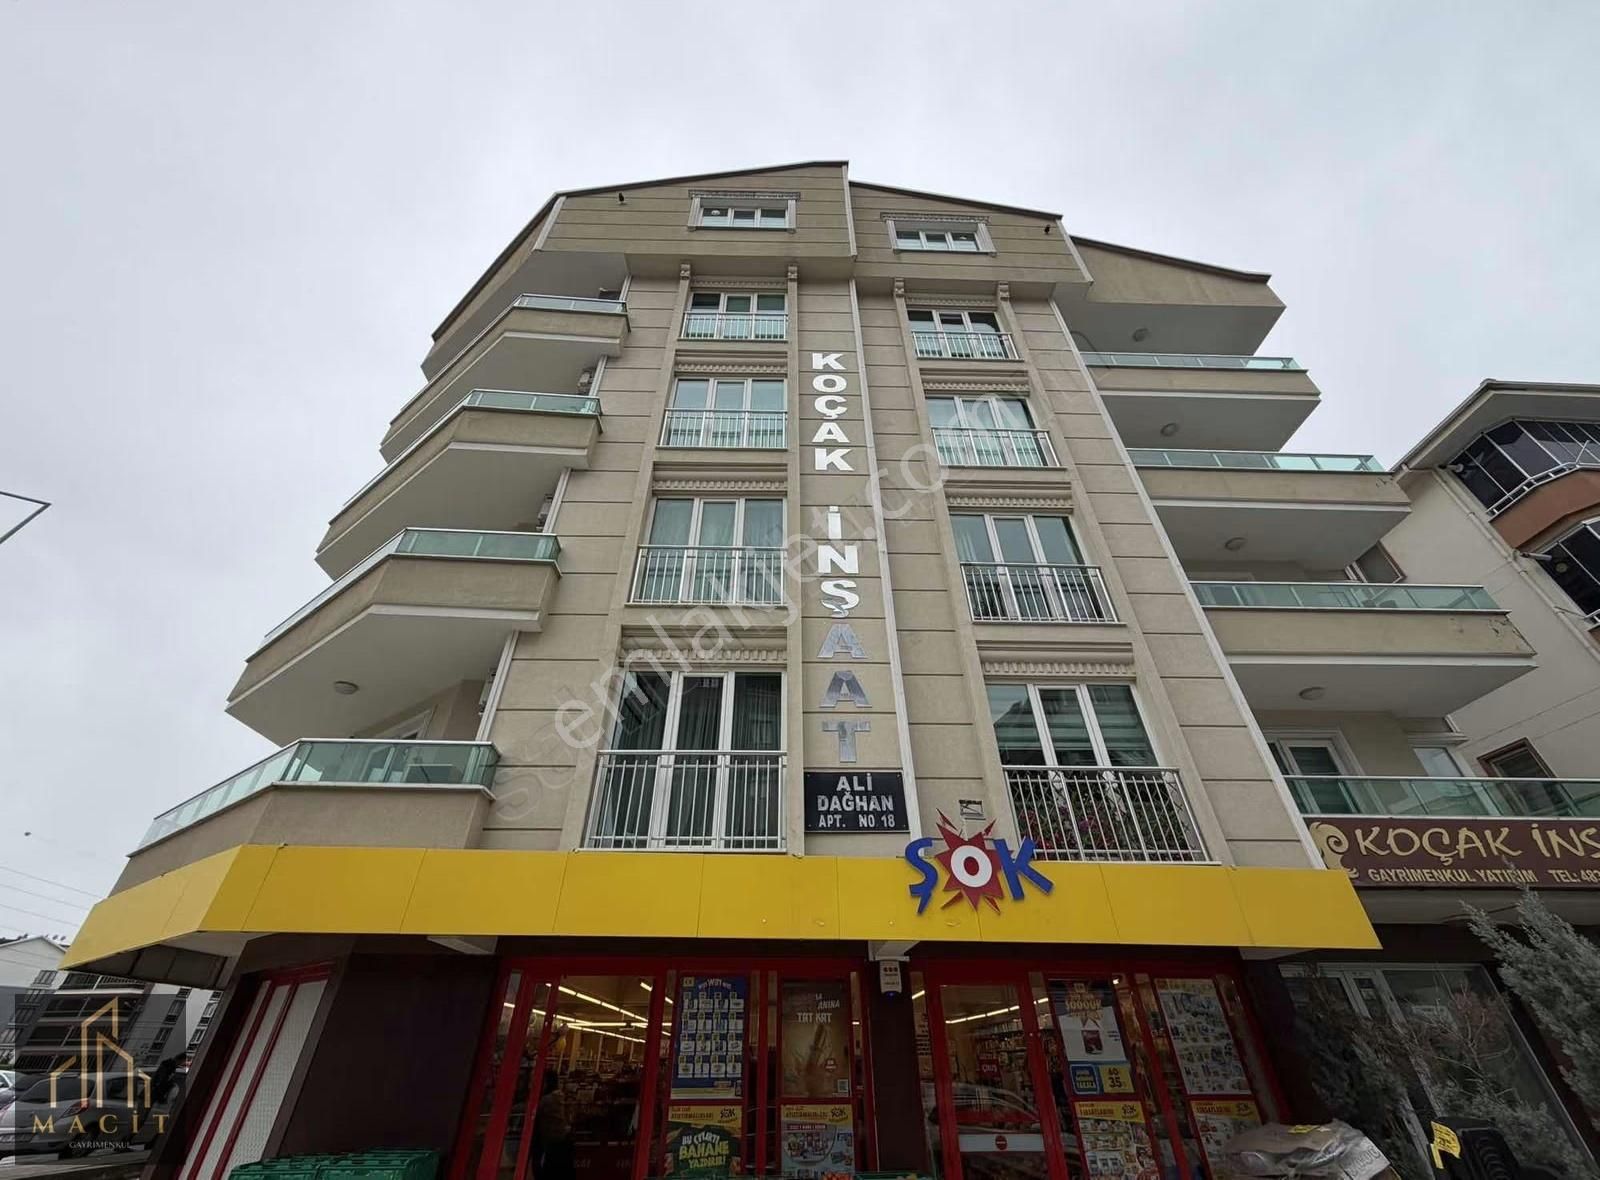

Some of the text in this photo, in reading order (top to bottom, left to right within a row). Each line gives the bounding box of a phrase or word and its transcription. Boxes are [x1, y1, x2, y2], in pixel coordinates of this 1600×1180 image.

[811, 352, 873, 763] KOÇAK İNŞAAT
[836, 772, 873, 792] ALİ
[816, 790, 895, 812] DAĞHAN
[818, 814, 896, 828] APT. NO 18
[1354, 825, 1523, 866] KOÇAK
[904, 836, 1054, 916] ŞOK
[1367, 866, 1477, 883] GAYRİMENKUL
